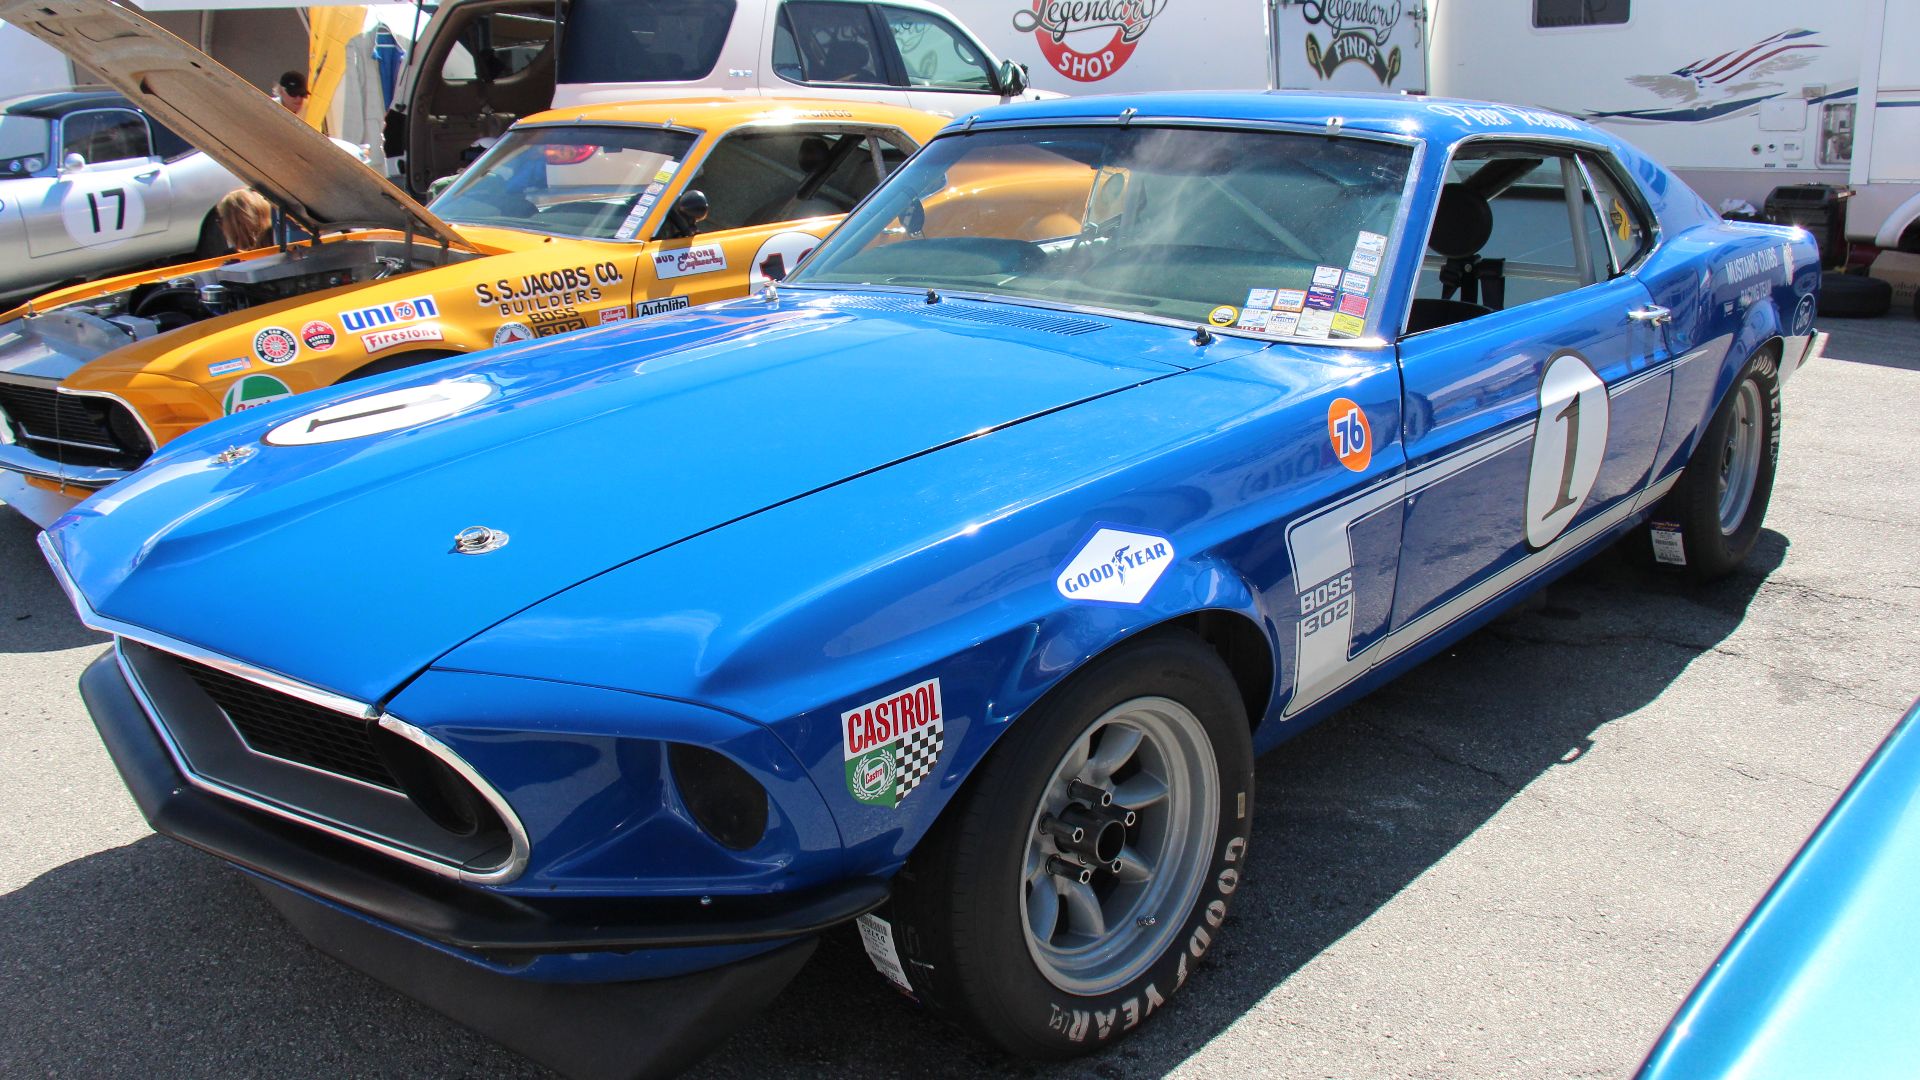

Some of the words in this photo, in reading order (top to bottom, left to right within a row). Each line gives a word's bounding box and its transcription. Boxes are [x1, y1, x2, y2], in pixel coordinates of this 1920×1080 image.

[1059, 51, 1115, 78] SHOP
[1334, 36, 1378, 65] FINDS
[87, 187, 126, 234] 17
[595, 261, 623, 283] CO.
[655, 254, 675, 264] BUD
[1726, 252, 1758, 285] MUSTANG
[1758, 247, 1778, 273] CLUBS
[397, 305, 412, 318] 76
[500, 287, 602, 316] BUILDERS
[641, 298, 687, 318] Autolite
[528, 307, 580, 325] BOSS
[537, 320, 582, 337] 302
[366, 329, 438, 349] Firestone
[1334, 408, 1365, 459] 76
[1541, 391, 1580, 521] 1
[1301, 573, 1352, 615] BOSS
[1304, 599, 1349, 637] 302
[847, 683, 940, 754] CASTROL
[865, 765, 885, 785] Castrol
